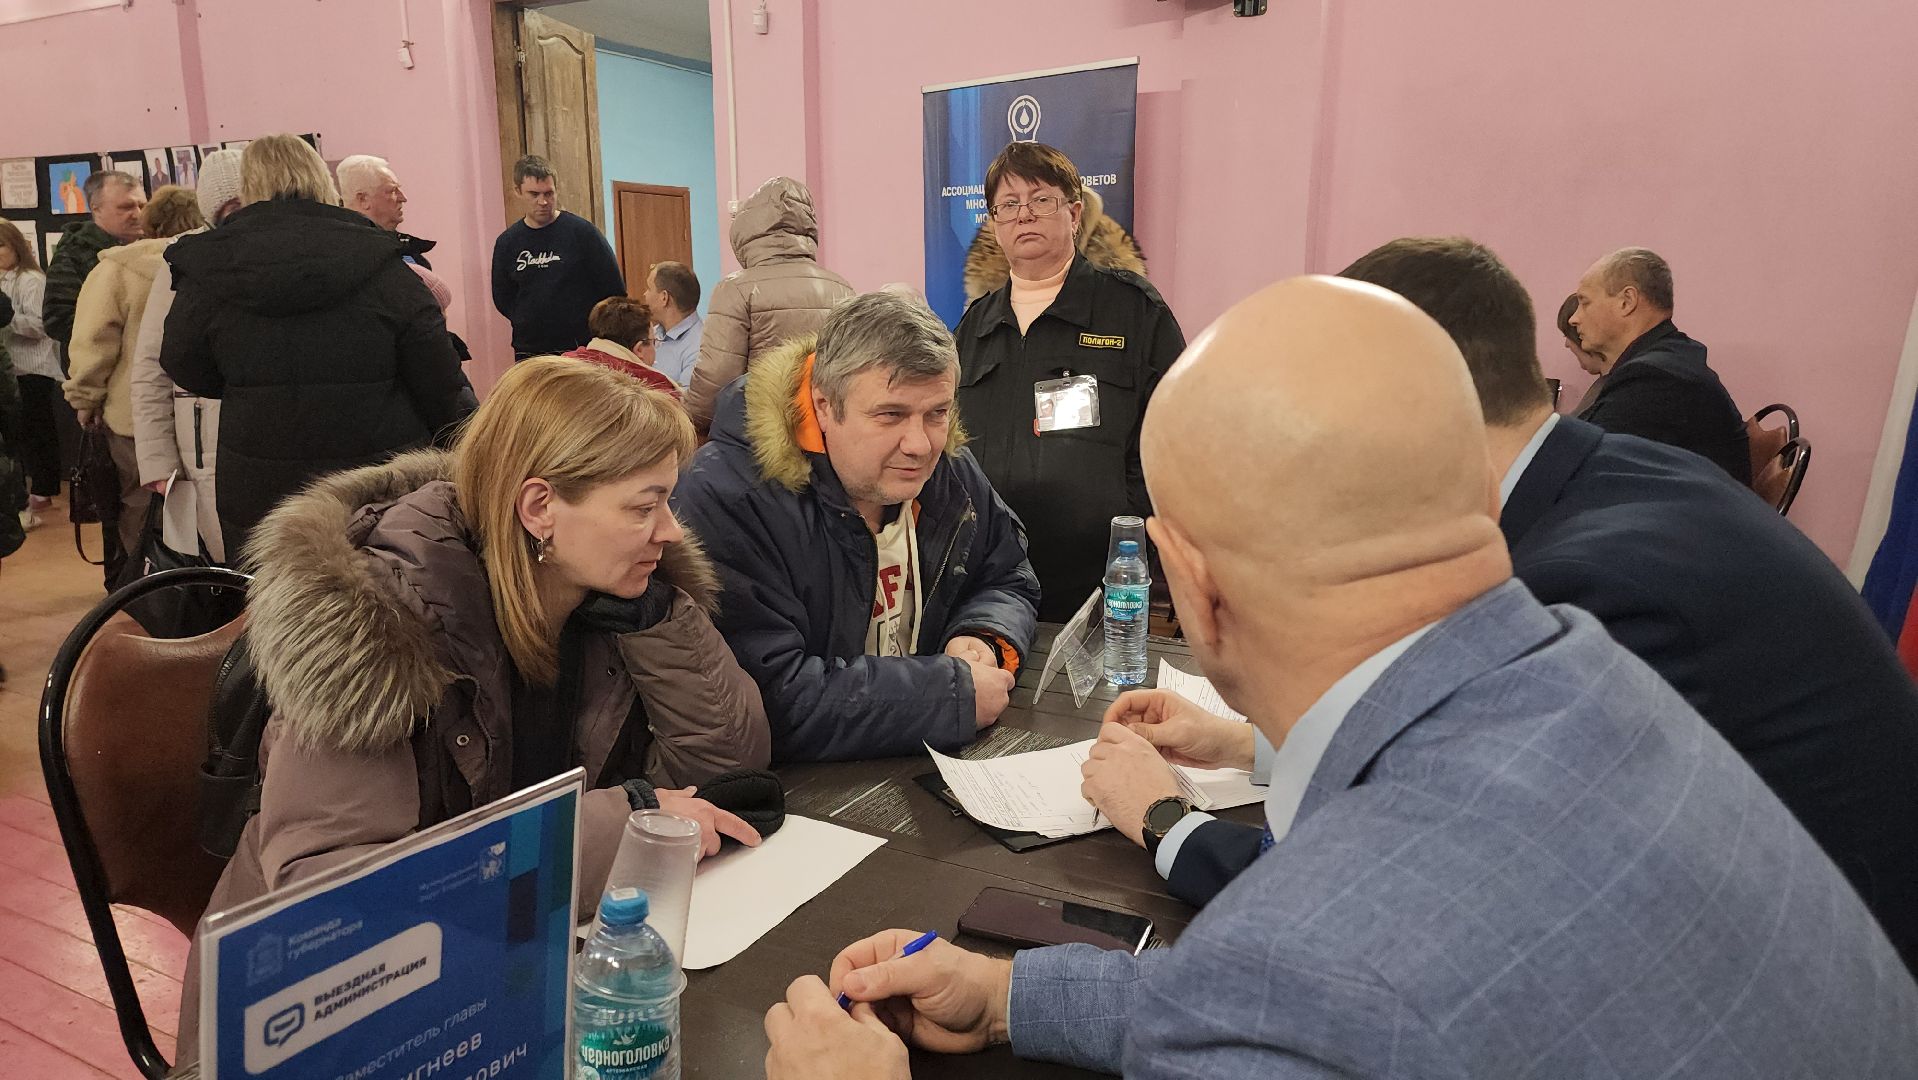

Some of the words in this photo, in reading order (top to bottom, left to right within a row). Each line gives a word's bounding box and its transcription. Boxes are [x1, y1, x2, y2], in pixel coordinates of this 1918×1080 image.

[941, 184, 985, 198] АССОЦИАЦ
[1080, 174, 1117, 187] ОВЕТОВ
[1082, 336, 1122, 347] ПОЛИГОН-2
[314, 962, 386, 1007] ВЫЕЗДНАЯ
[314, 956, 427, 1022] АДМИНИСТРАЦИЯ
[444, 998, 488, 1032] главы
[465, 1042, 527, 1080] ович
